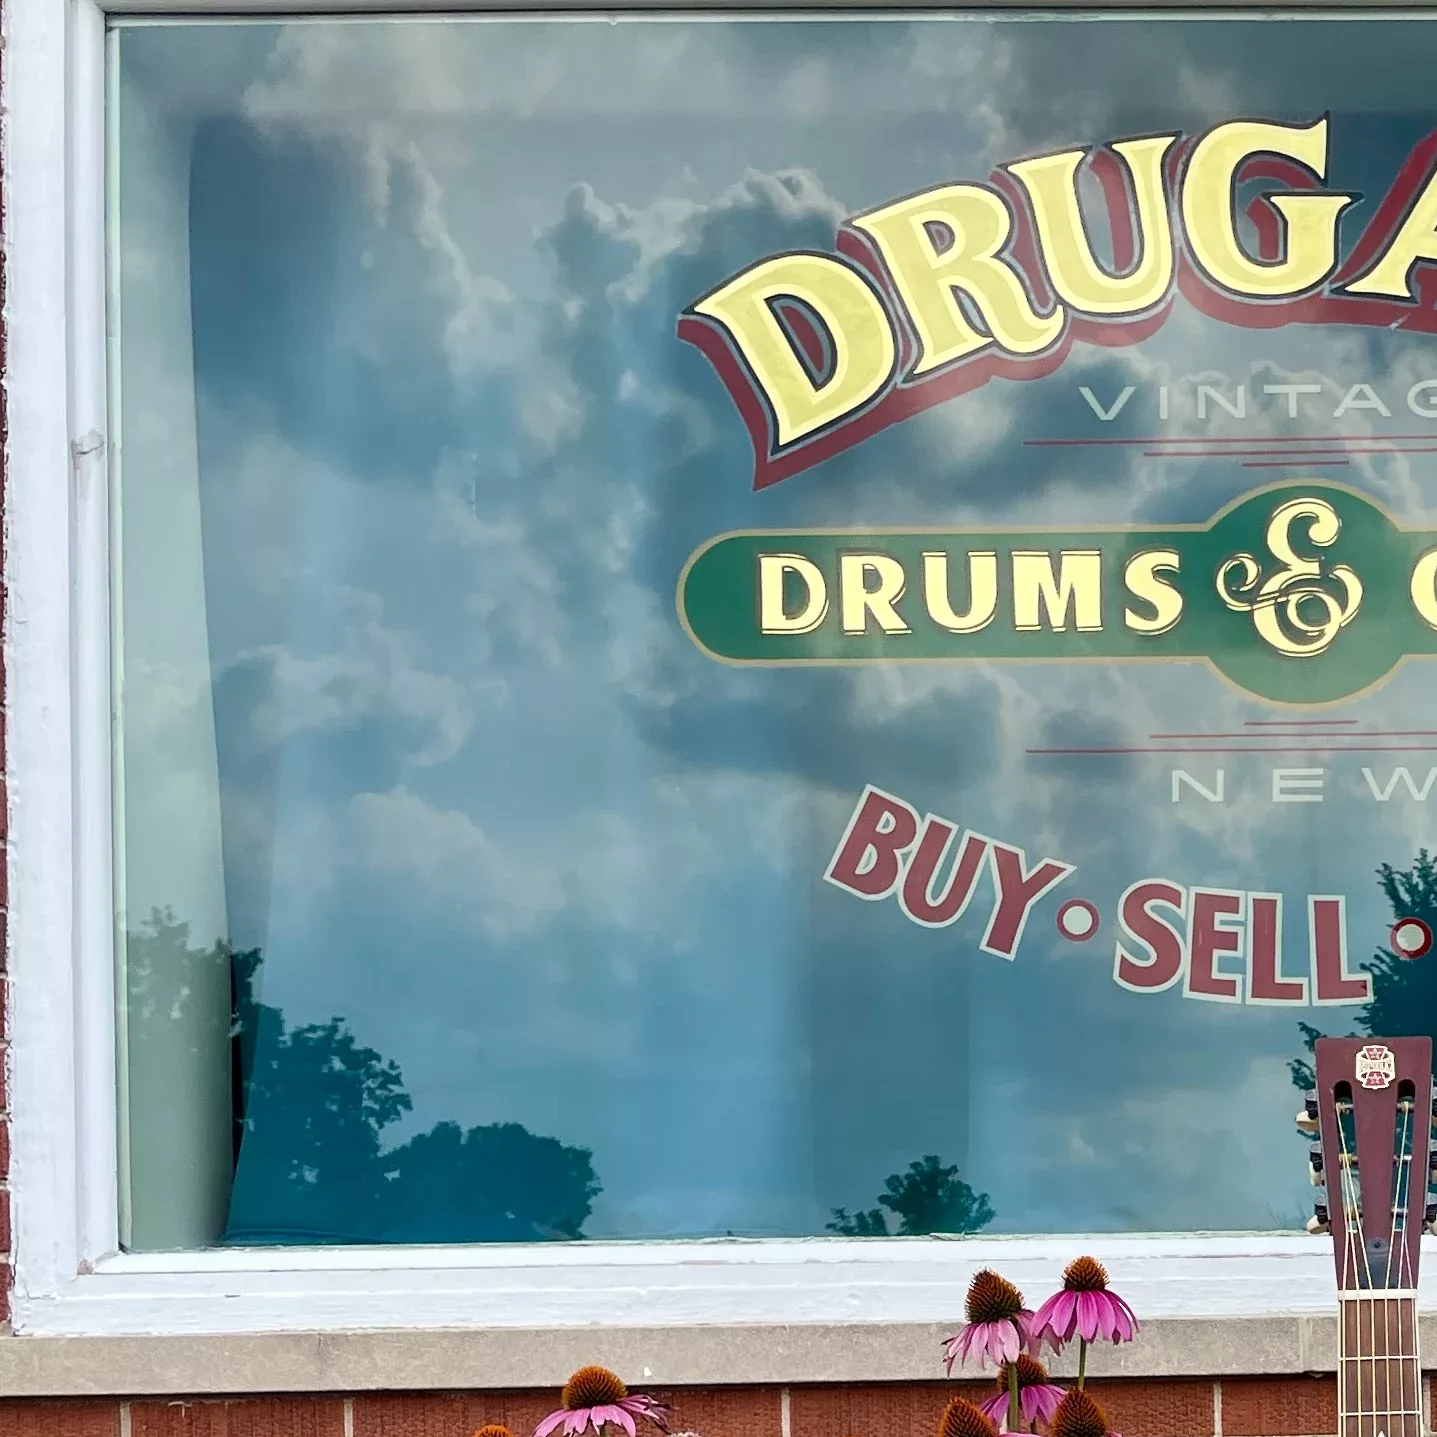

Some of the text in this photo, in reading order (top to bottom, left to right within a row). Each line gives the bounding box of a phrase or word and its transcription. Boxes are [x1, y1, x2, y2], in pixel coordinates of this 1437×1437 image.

[758, 549, 1184, 636] DRUMS
[1215, 497, 1364, 658] &
[823, 784, 1077, 961] BUY
[1113, 878, 1375, 1007] SELL
